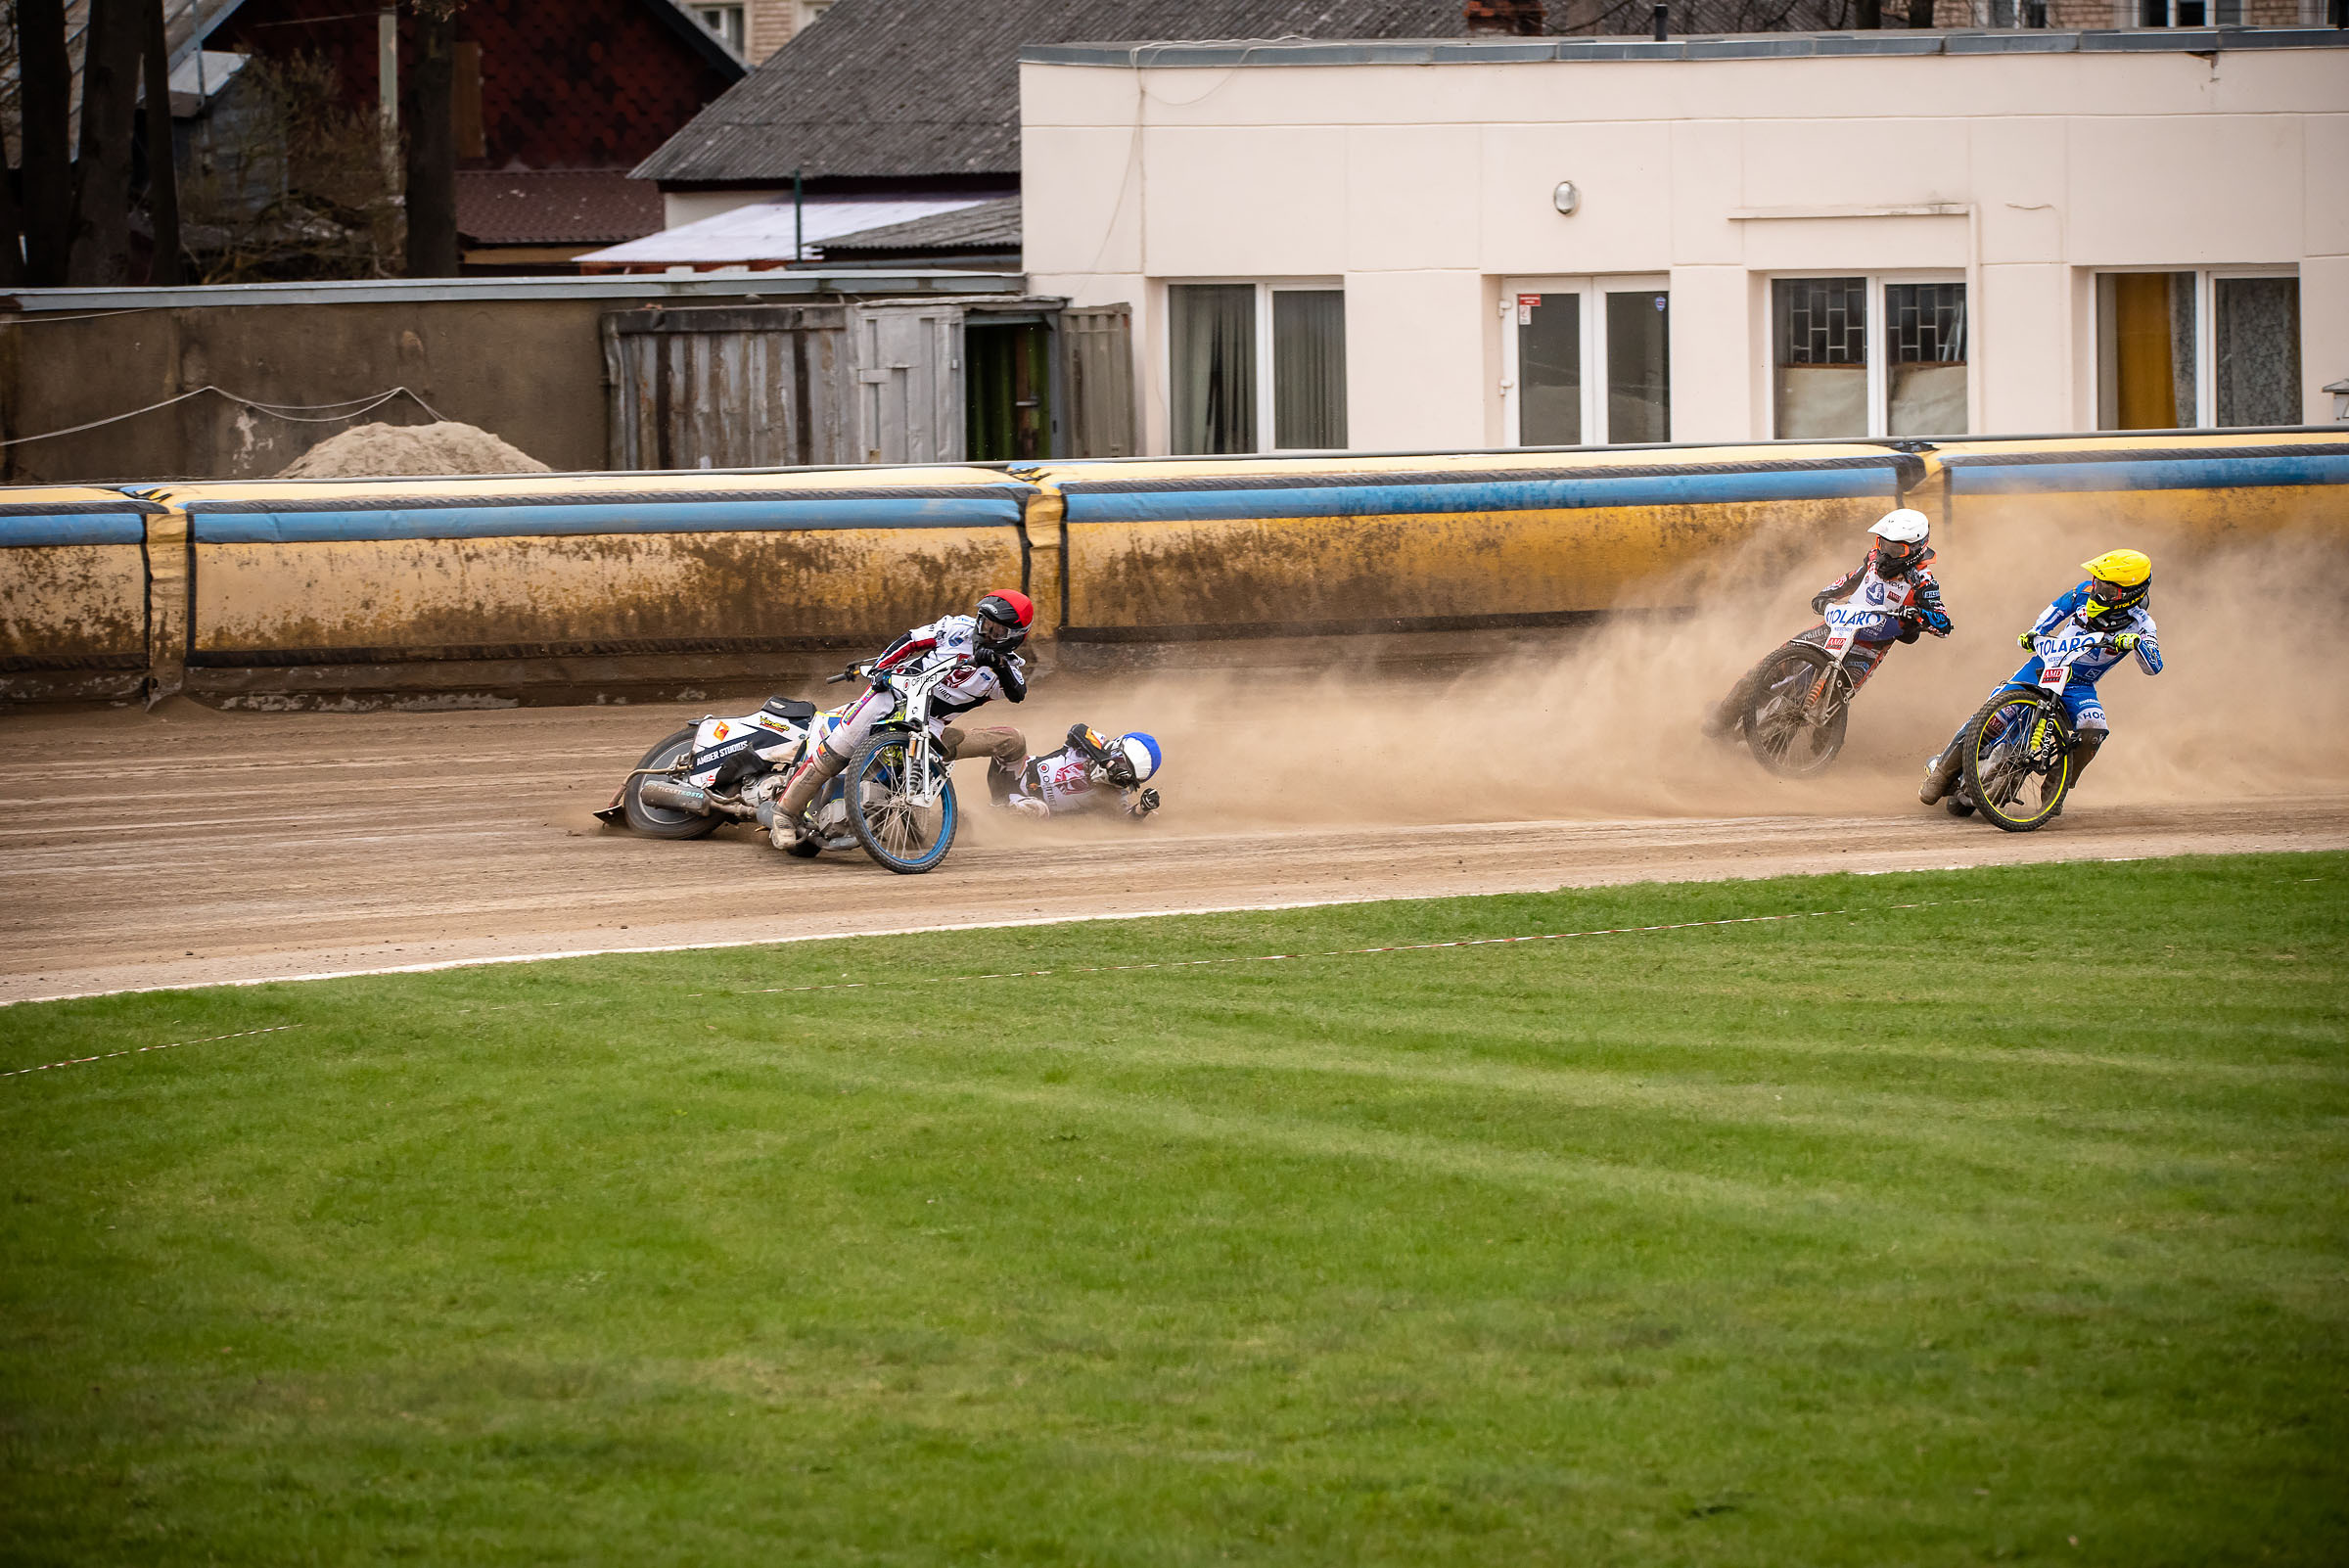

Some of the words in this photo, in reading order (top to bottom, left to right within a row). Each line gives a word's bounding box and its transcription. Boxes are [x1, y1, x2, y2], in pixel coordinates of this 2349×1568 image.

[911, 674, 938, 686] OPTIBET
[697, 750, 719, 765] AMBER
[719, 740, 749, 757] STUDIOS
